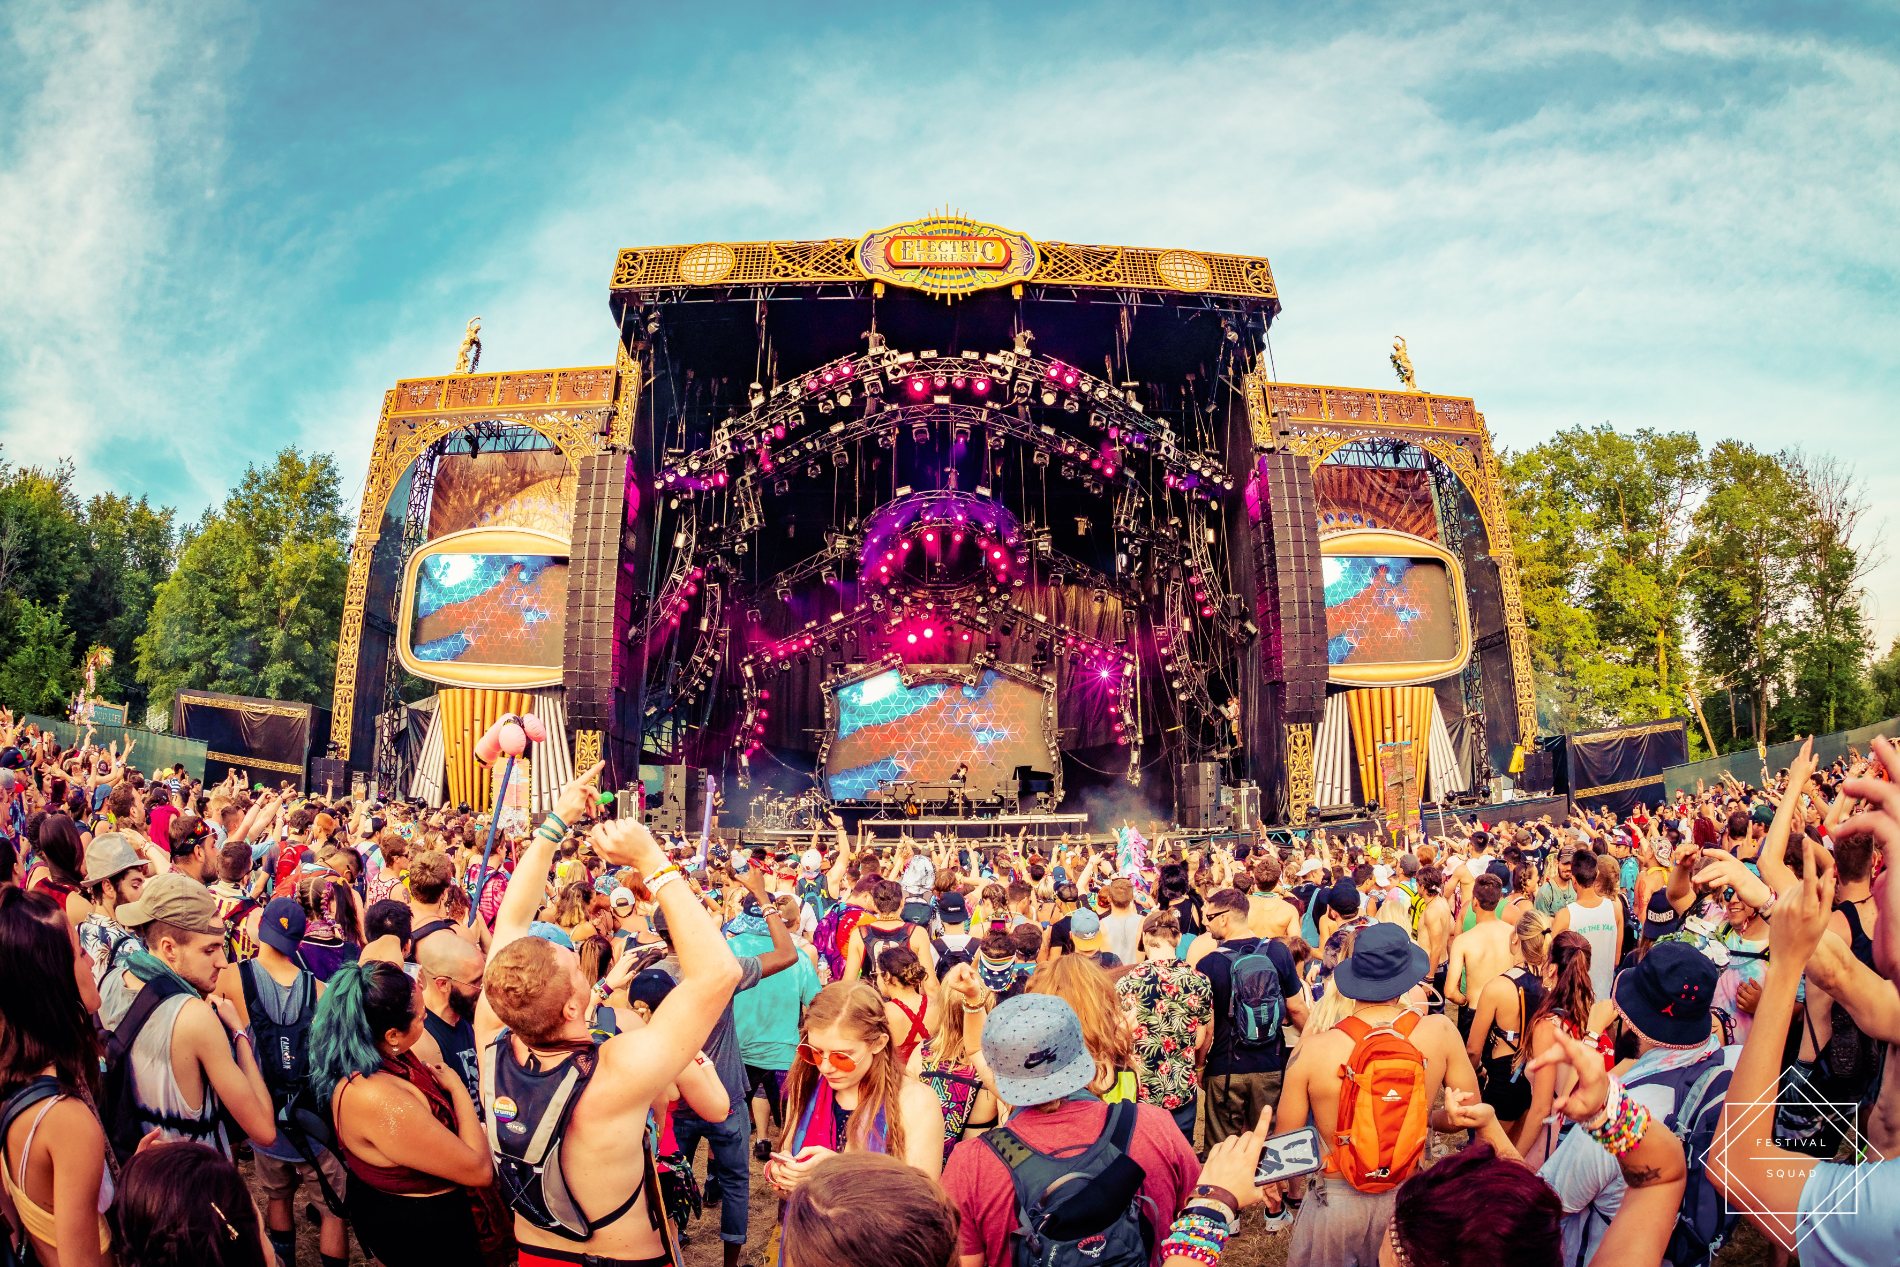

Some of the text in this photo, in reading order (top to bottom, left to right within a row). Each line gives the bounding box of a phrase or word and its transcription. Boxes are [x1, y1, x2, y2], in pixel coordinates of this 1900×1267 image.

[901, 239, 996, 262] ELECTRIC
[918, 252, 978, 262] FOREST
[1077, 1234, 1105, 1249] OSPREY
